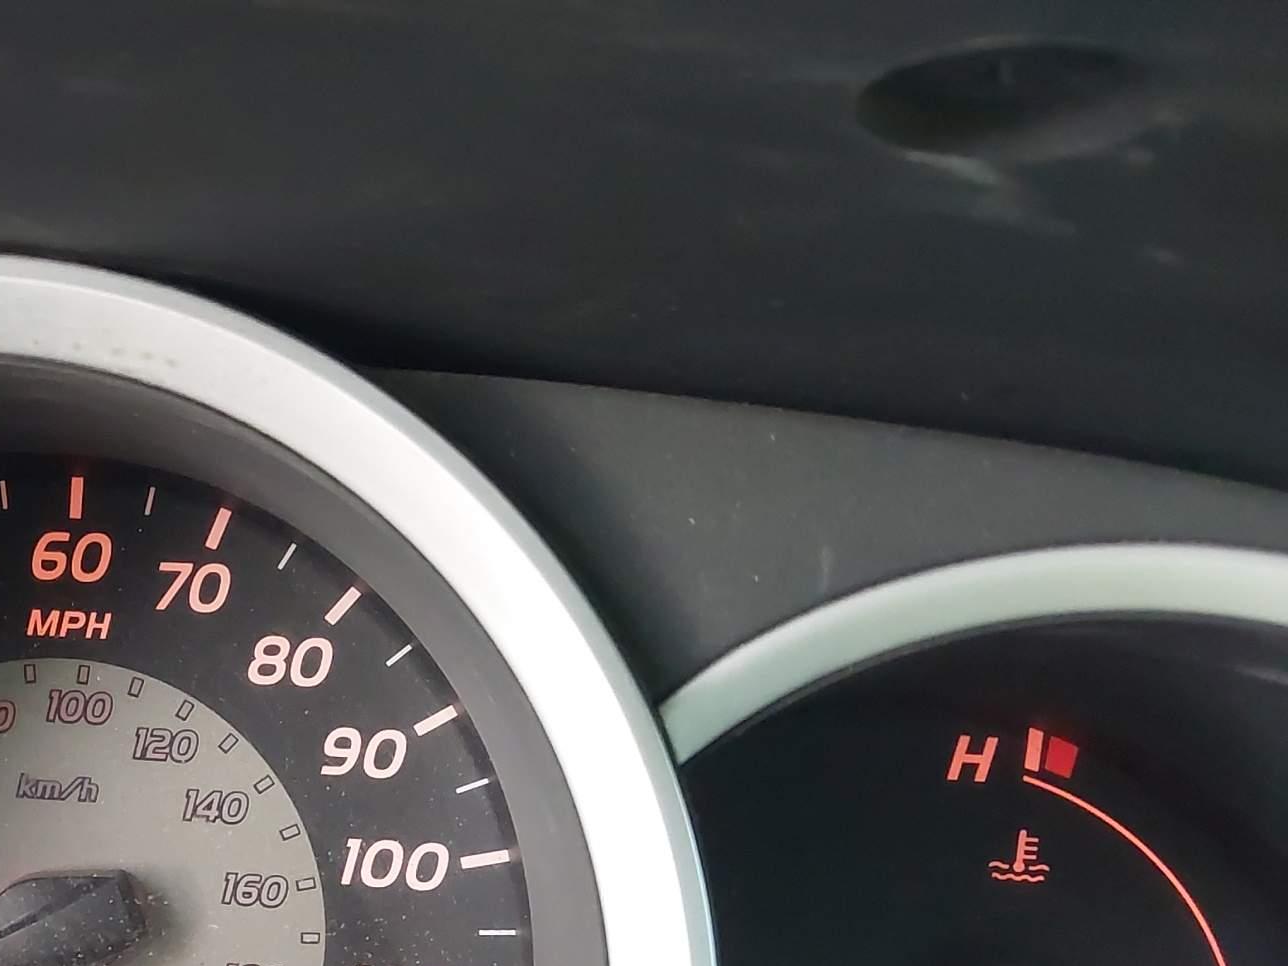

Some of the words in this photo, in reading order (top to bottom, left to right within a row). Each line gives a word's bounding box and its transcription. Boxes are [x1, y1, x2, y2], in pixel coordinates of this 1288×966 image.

[30, 531, 112, 583] 60
[155, 561, 231, 613] 70
[25, 608, 112, 640] MPH
[246, 635, 333, 688] 80
[45, 689, 113, 725] 100
[132, 727, 199, 763] 120
[320, 727, 407, 779] 90
[946, 734, 999, 783] H
[15, 772, 99, 803] km/h
[182, 788, 249, 824] 140
[340, 837, 449, 891] 100
[221, 872, 288, 908] 160
